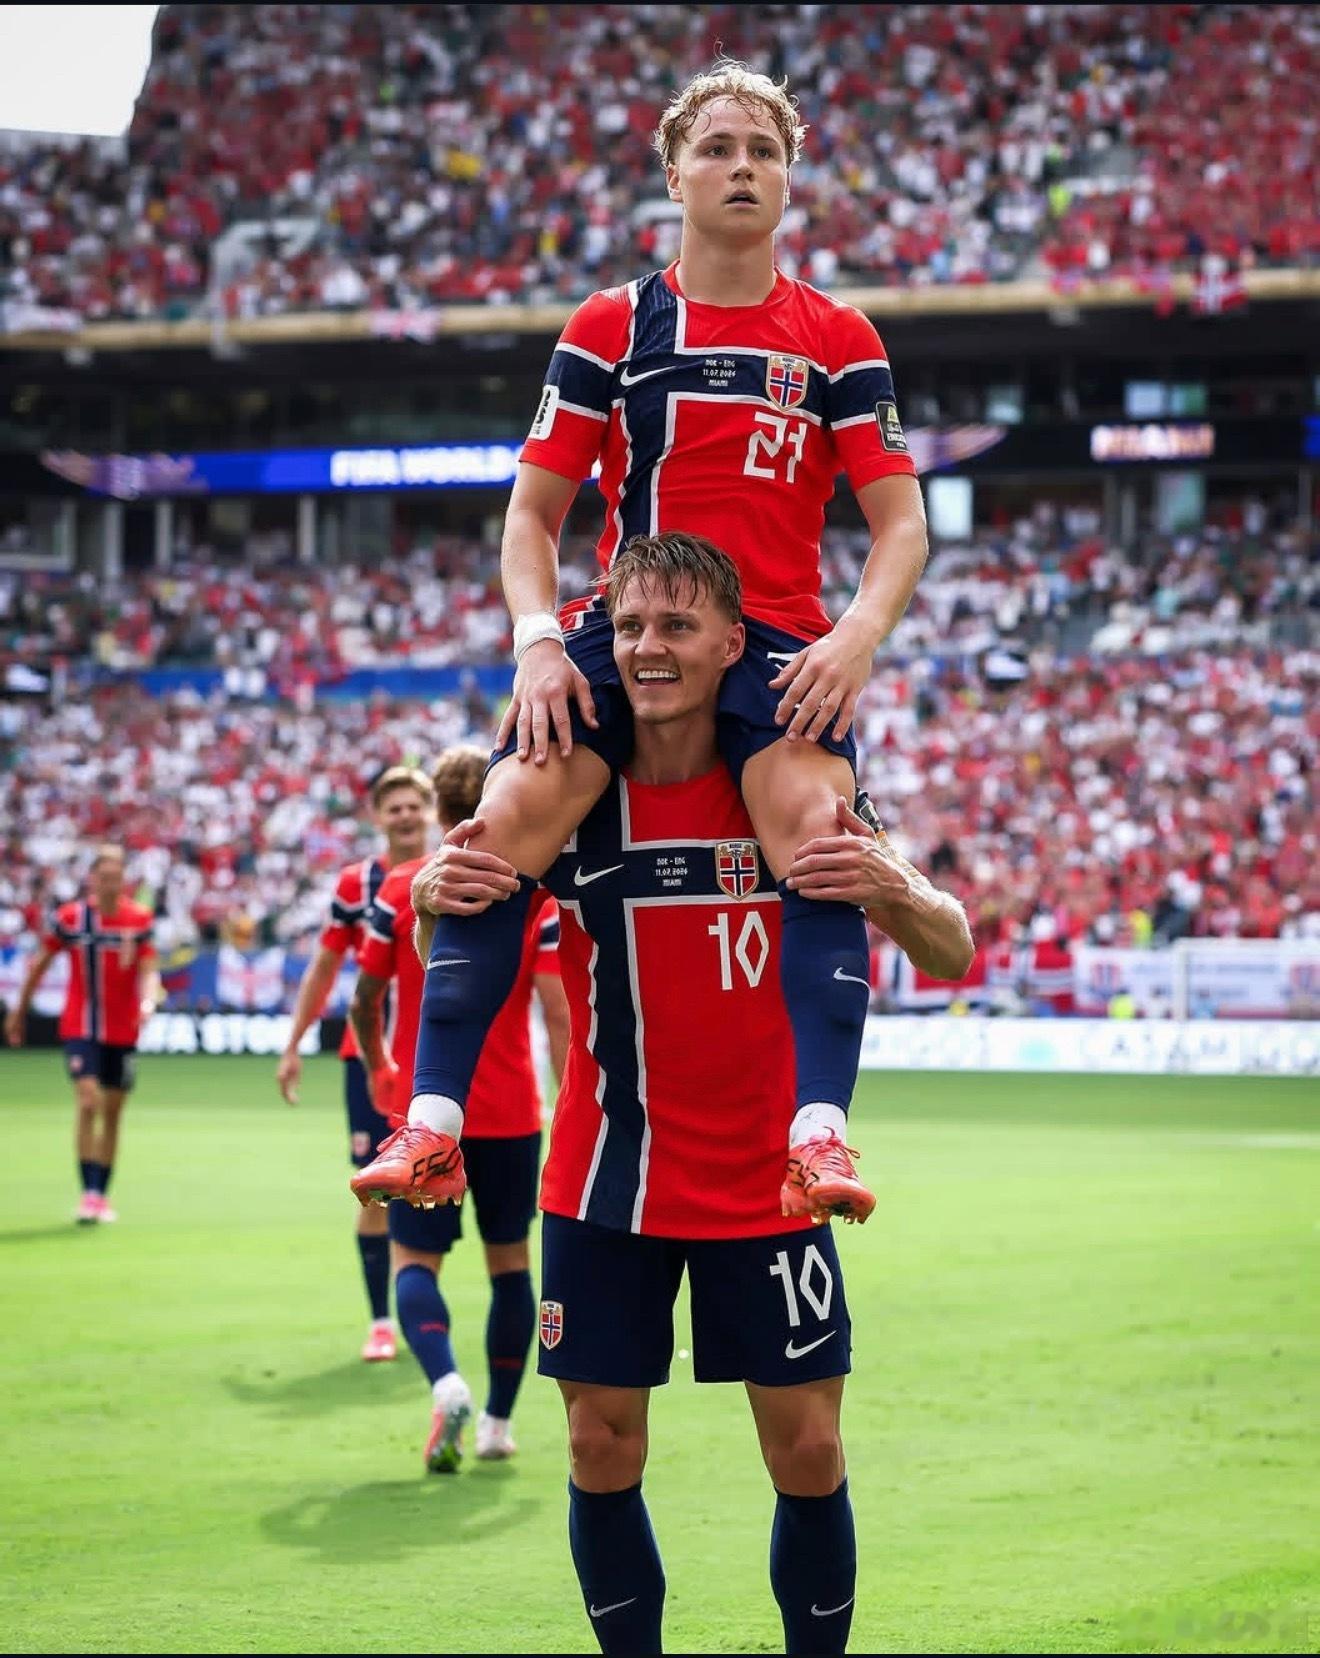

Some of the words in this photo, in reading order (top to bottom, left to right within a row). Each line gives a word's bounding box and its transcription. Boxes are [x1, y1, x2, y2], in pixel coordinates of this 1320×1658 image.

[708, 379, 729, 387] MIAMI
[743, 411, 808, 484] 21
[663, 878, 682, 887] MIAMI
[708, 911, 770, 991] 10
[410, 1146, 463, 1187] F50
[769, 1244, 833, 1327] 10
